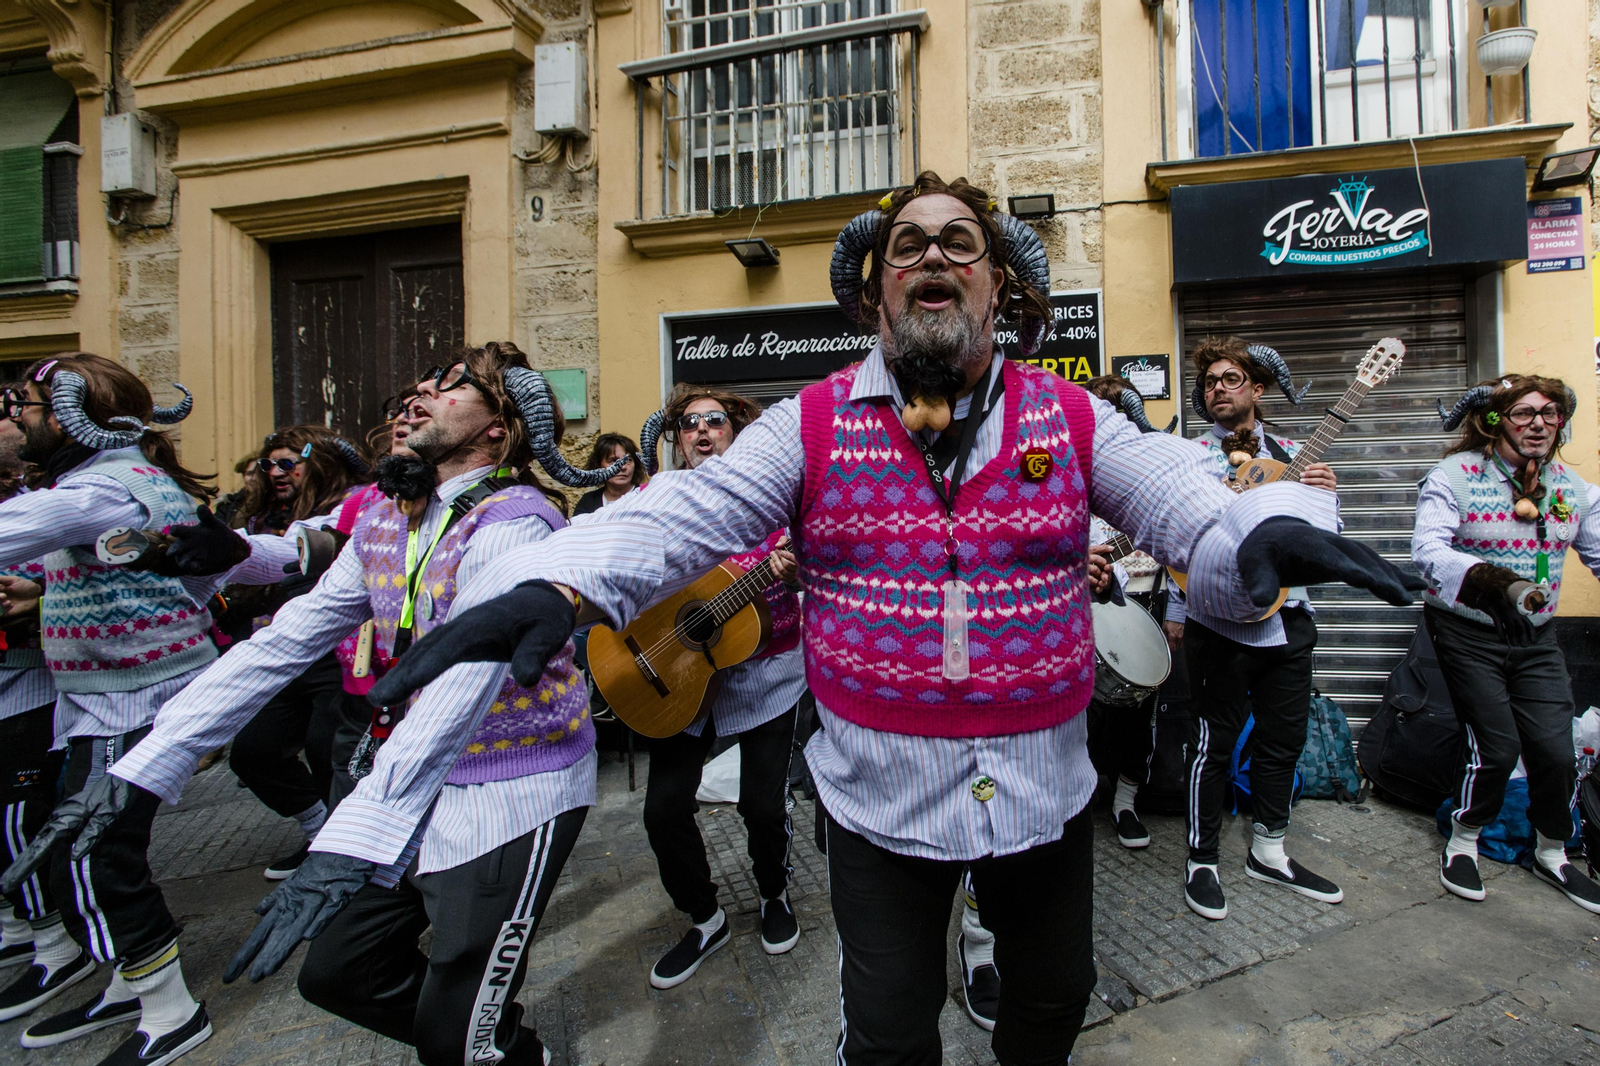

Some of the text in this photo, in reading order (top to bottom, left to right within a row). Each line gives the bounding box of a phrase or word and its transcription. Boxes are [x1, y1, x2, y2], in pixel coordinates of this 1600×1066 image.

[531, 196, 543, 222] 9
[1531, 219, 1577, 230] ALARMA
[1312, 232, 1374, 250] JOYERÍA
[1530, 230, 1579, 240] CONECTADA
[1289, 238, 1421, 262] COMPARE NUESTROS PRECIOS
[1545, 240, 1576, 249] HORAS
[1048, 305, 1093, 319] RICES
[1061, 325, 1097, 340] -40%
[676, 330, 880, 361] Taller de Reparacione
